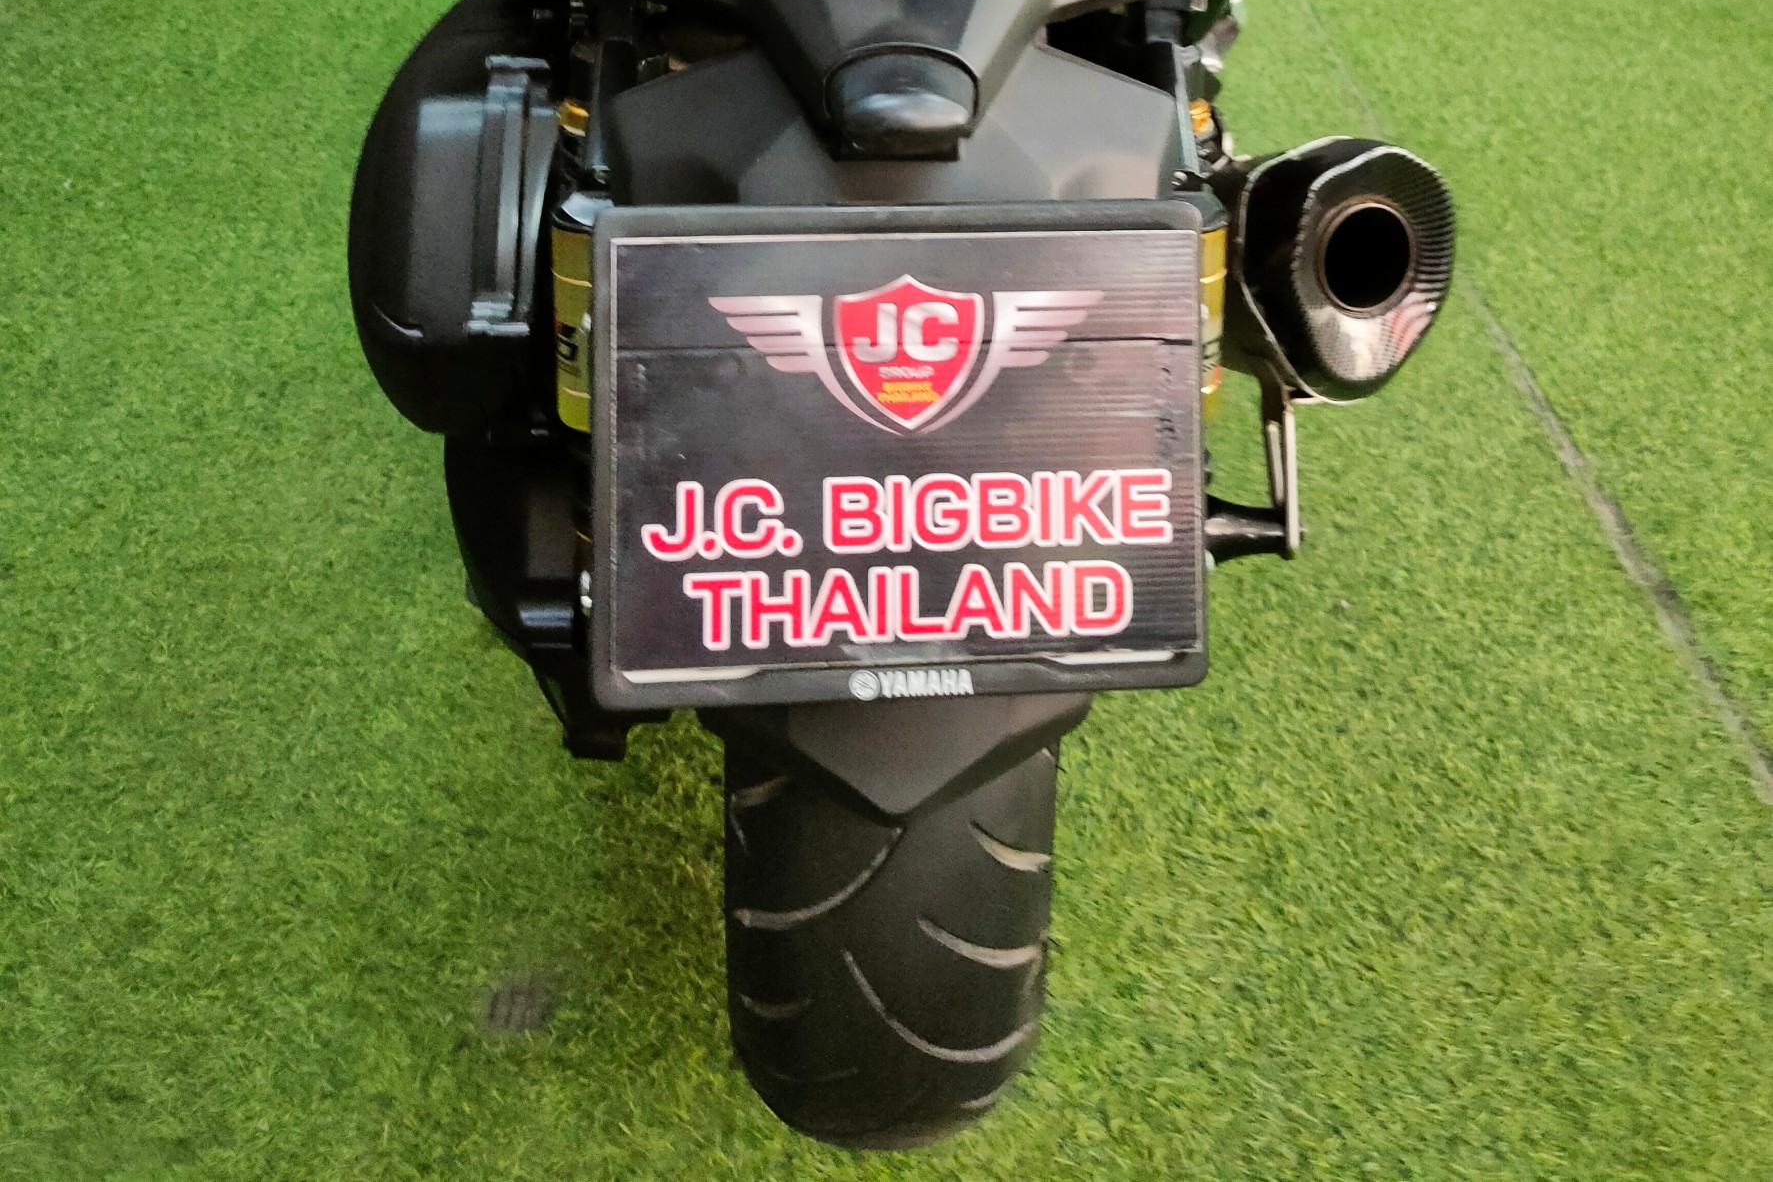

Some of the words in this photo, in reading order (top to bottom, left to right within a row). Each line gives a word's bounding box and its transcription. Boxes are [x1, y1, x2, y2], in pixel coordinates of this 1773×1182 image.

[852, 301, 960, 363] JC
[641, 478, 803, 561] J.C.
[823, 469, 1173, 553] BIGBIKE
[683, 560, 1133, 651] THAILAND
[878, 669, 975, 698] YAMAHA
